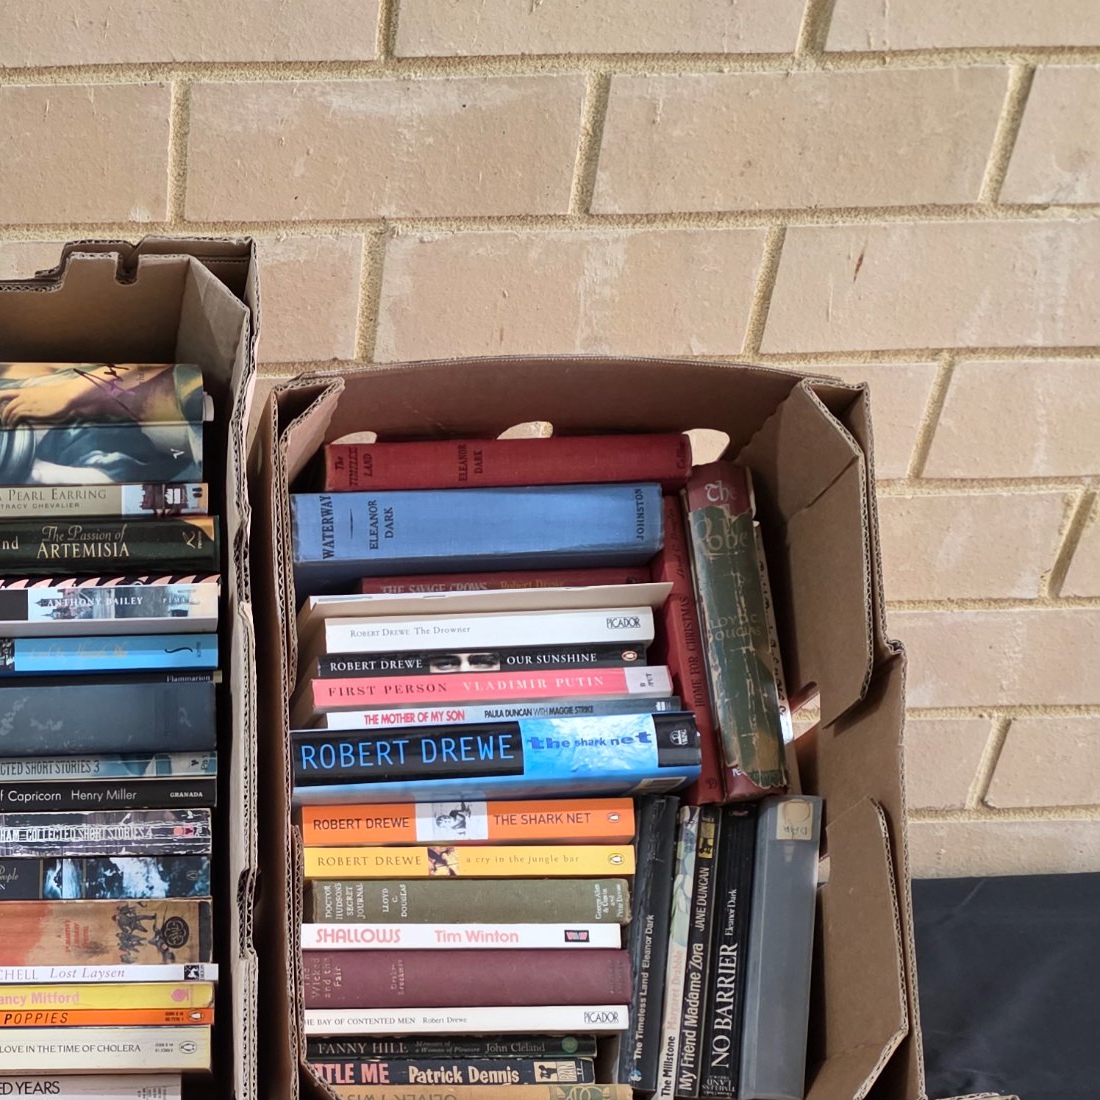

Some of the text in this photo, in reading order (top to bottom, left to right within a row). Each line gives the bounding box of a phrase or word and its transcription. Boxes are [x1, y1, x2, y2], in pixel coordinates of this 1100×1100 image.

[8, 489, 47, 501] PEARL
[52, 488, 107, 500] EARRING
[322, 495, 335, 559] WATERWAY
[368, 499, 394, 550] ELEANOR DARK
[37, 542, 130, 559] ARTEMISIA
[330, 659, 423, 671] ROBERT DREWE
[506, 652, 597, 664] OUR SUNSHINE
[328, 682, 448, 696] FIRST PERSON
[463, 676, 604, 692] VLADIMIR PUTIN
[301, 734, 515, 770] ROBERT DREWE
[7, 789, 62, 803] Capricorn
[313, 816, 409, 831] ROBERT DREWE
[493, 812, 591, 826] THE SHARK NET
[316, 929, 519, 943] SHALLOWS Tim Winton
[711, 943, 739, 1068] NO BARRIER
[4, 1012, 68, 1025] POPPIES
[15, 1081, 60, 1095] YEARS
